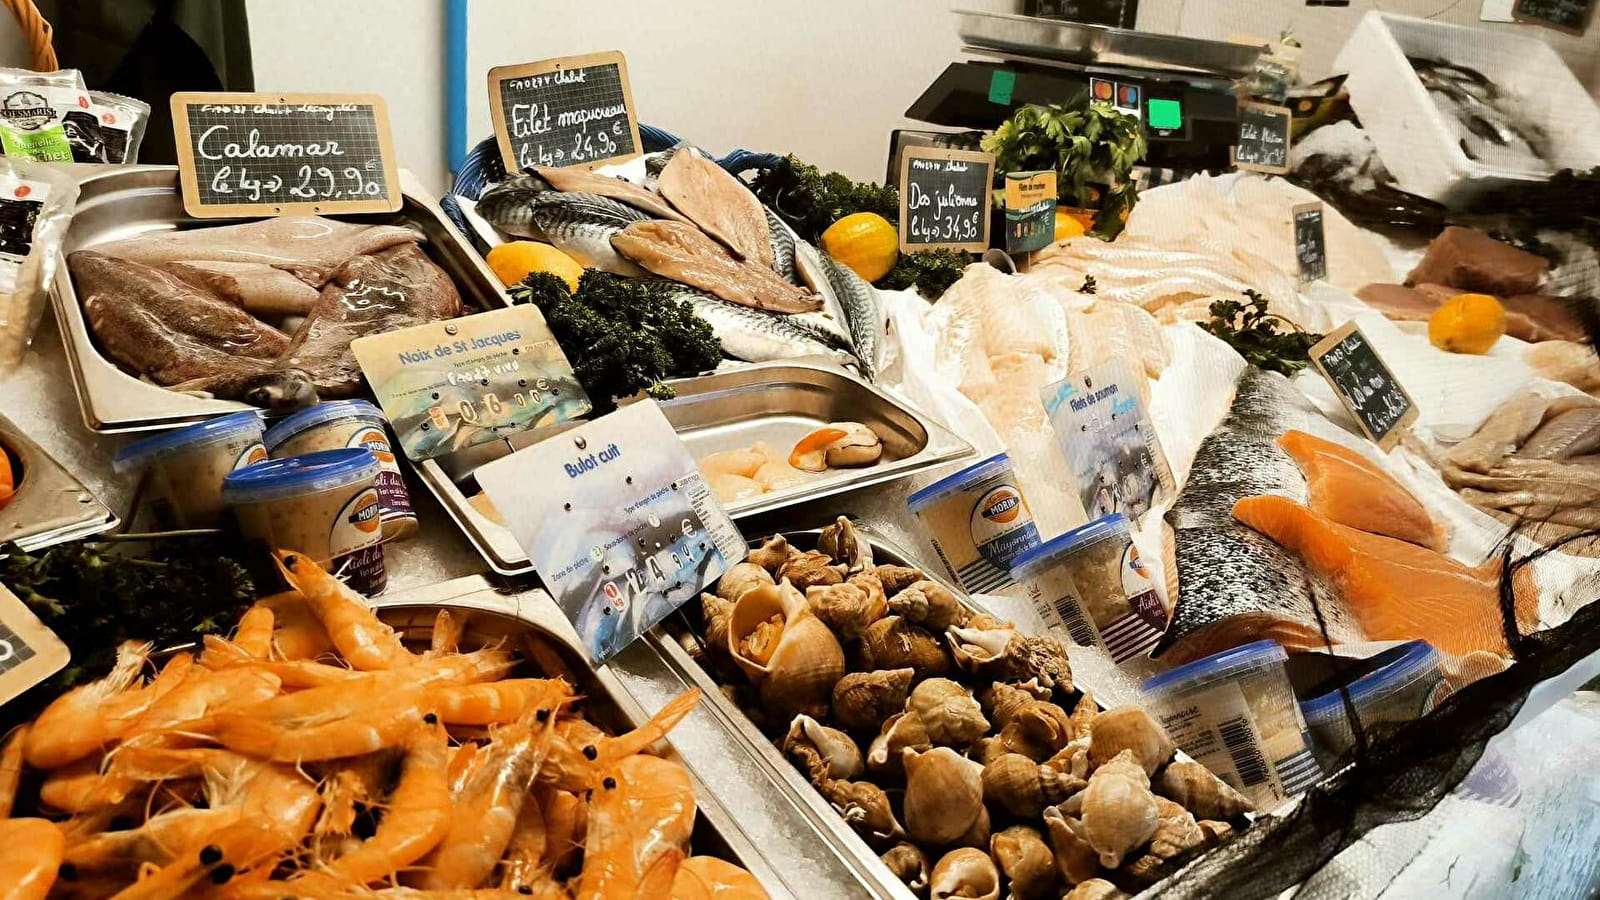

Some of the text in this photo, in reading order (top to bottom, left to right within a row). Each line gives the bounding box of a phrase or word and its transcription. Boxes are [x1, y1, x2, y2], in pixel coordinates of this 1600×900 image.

[512, 103, 551, 137] Filet
[198, 125, 344, 159] Calamar
[212, 166, 233, 193] le
[909, 182, 930, 209] Dos
[399, 350, 431, 365] Noix
[435, 345, 451, 358] de
[453, 340, 469, 353] St
[471, 330, 521, 350] Jacques
[1070, 397, 1087, 413] Filets
[1087, 391, 1097, 405] de
[563, 442, 621, 479] Bulot cuit
[990, 498, 1016, 515] MORIN
[681, 518, 698, 538] €
